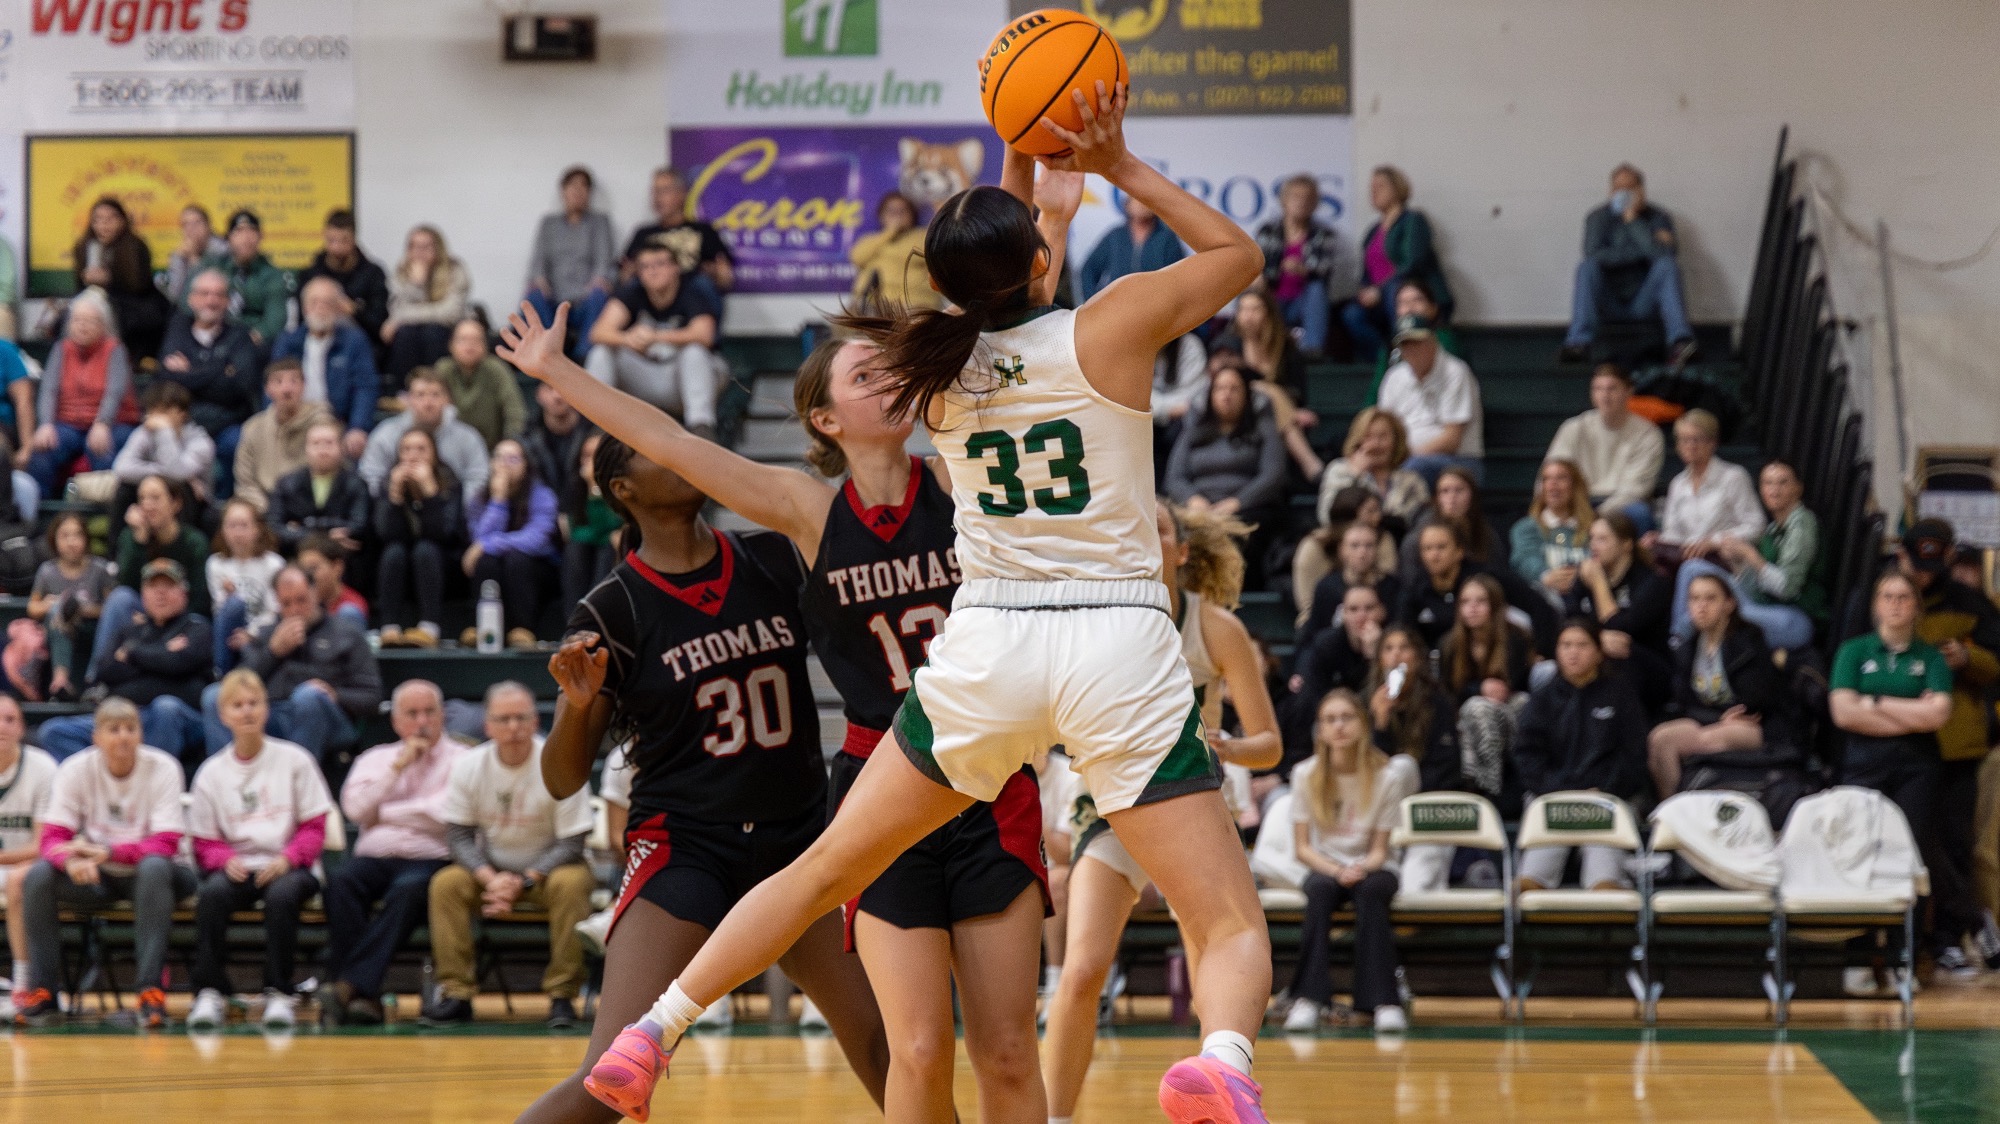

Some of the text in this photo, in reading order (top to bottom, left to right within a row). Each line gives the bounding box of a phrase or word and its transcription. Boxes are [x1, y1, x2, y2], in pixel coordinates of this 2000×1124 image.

[32, 0, 249, 44] Wights
[145, 34, 350, 62] SPORTING GOODS
[980, 14, 1052, 94] Wilson
[1128, 44, 1340, 80] after the game!
[726, 69, 943, 117] Holiday Inn
[683, 137, 865, 231] Caron
[964, 418, 1092, 517] 33
[827, 547, 963, 606] THOMAS
[661, 615, 796, 682] THOMAS
[695, 664, 792, 758] 30
[1416, 807, 1477, 823] HUSSON
[1550, 805, 1610, 822] HUSSON
